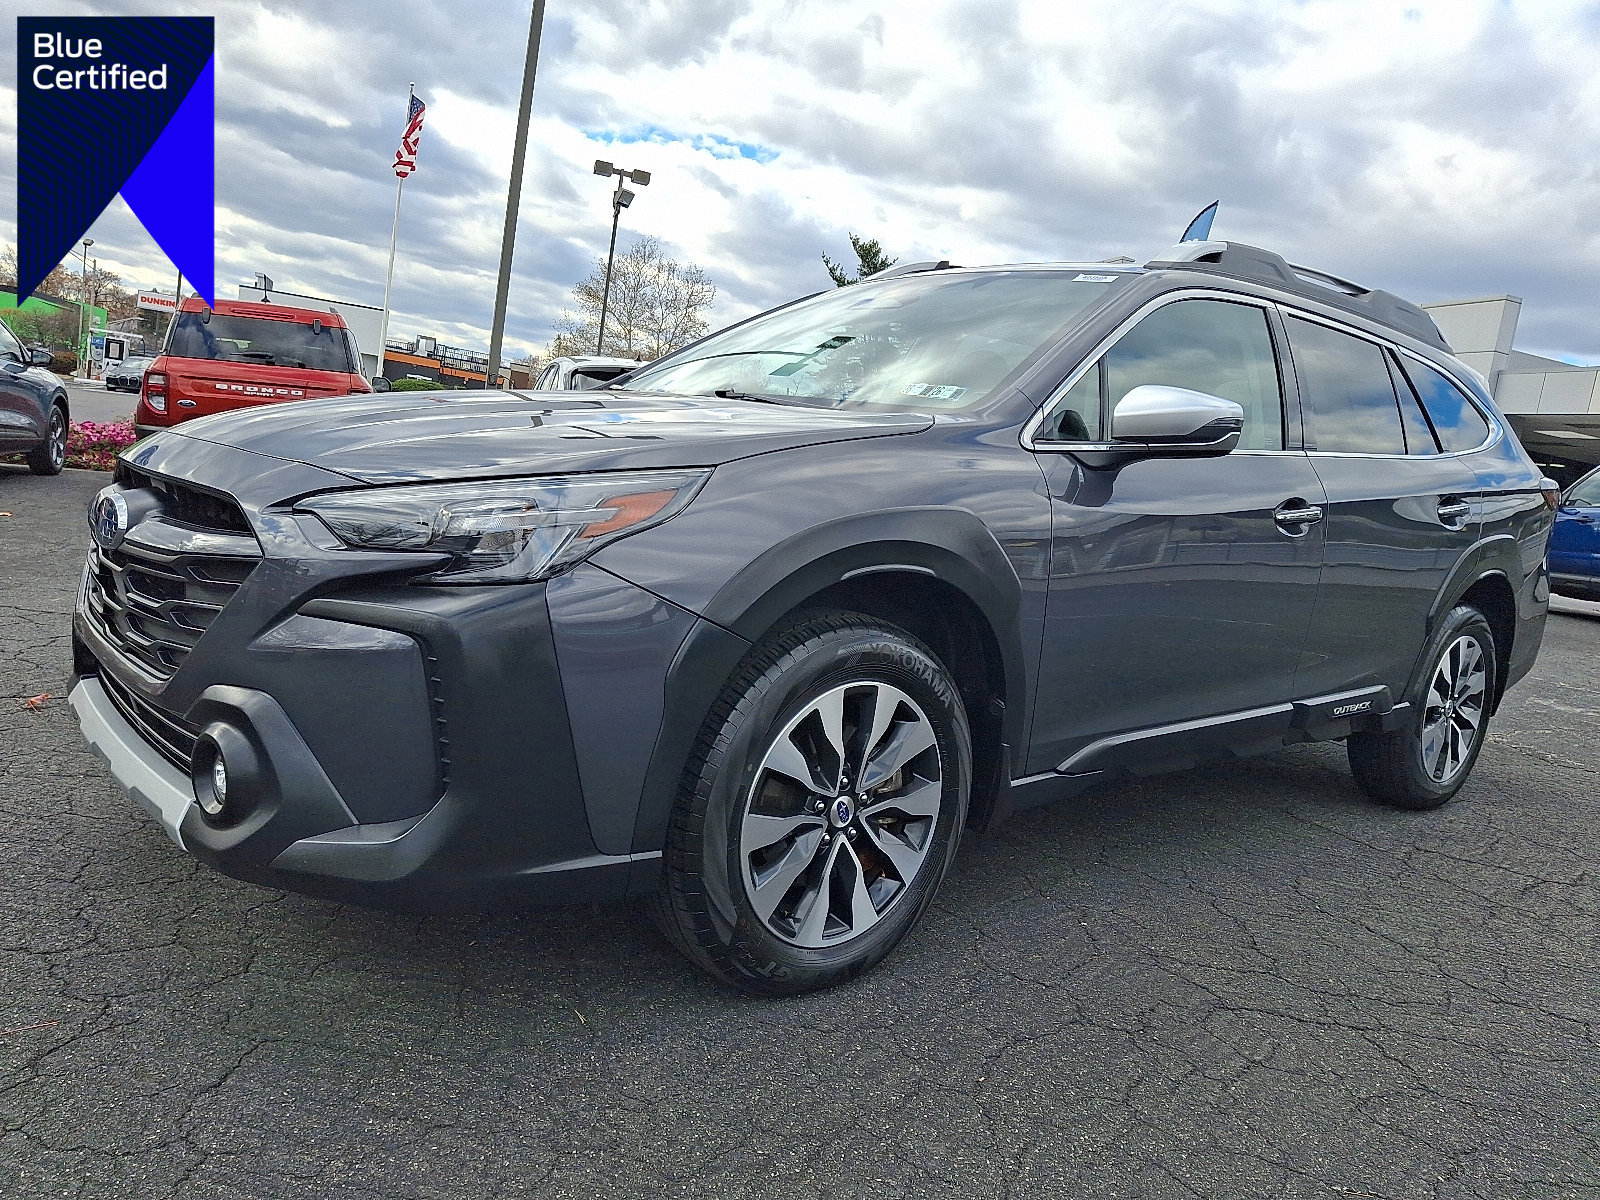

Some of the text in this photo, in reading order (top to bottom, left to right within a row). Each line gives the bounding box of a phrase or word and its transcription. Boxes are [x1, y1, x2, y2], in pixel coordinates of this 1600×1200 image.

[215, 383, 303, 396] BRONCO
[869, 643, 953, 709] YOKOHAMA
[1333, 701, 1372, 715] OUTBACK
